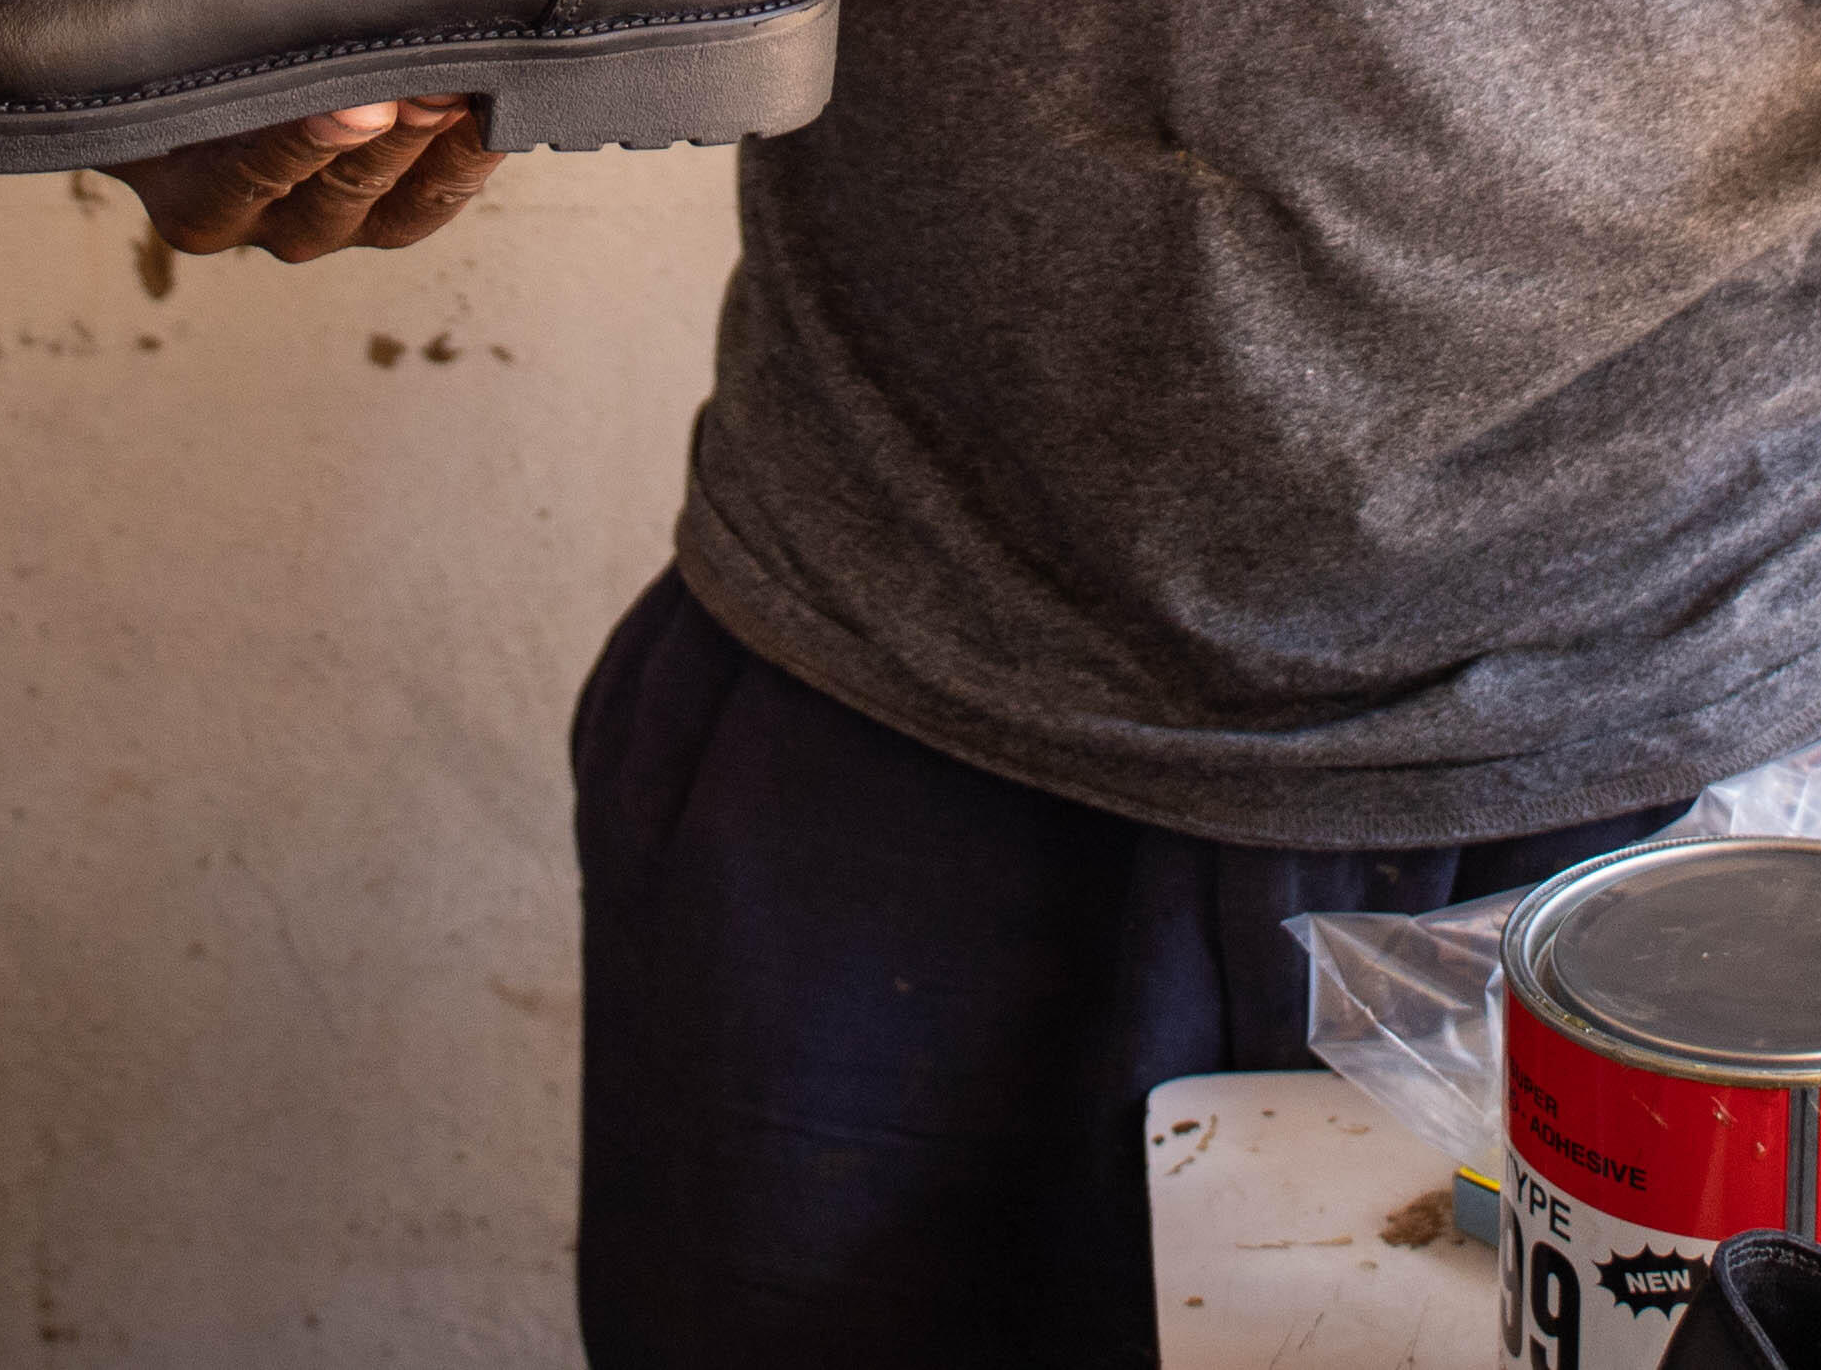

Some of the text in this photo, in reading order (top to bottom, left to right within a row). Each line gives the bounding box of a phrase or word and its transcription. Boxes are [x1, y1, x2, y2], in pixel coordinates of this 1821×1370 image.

[1530, 1115, 1648, 1192] ADHESIVE
[1501, 1194, 1580, 1370] 99
[1624, 1268, 1691, 1295] NEW
